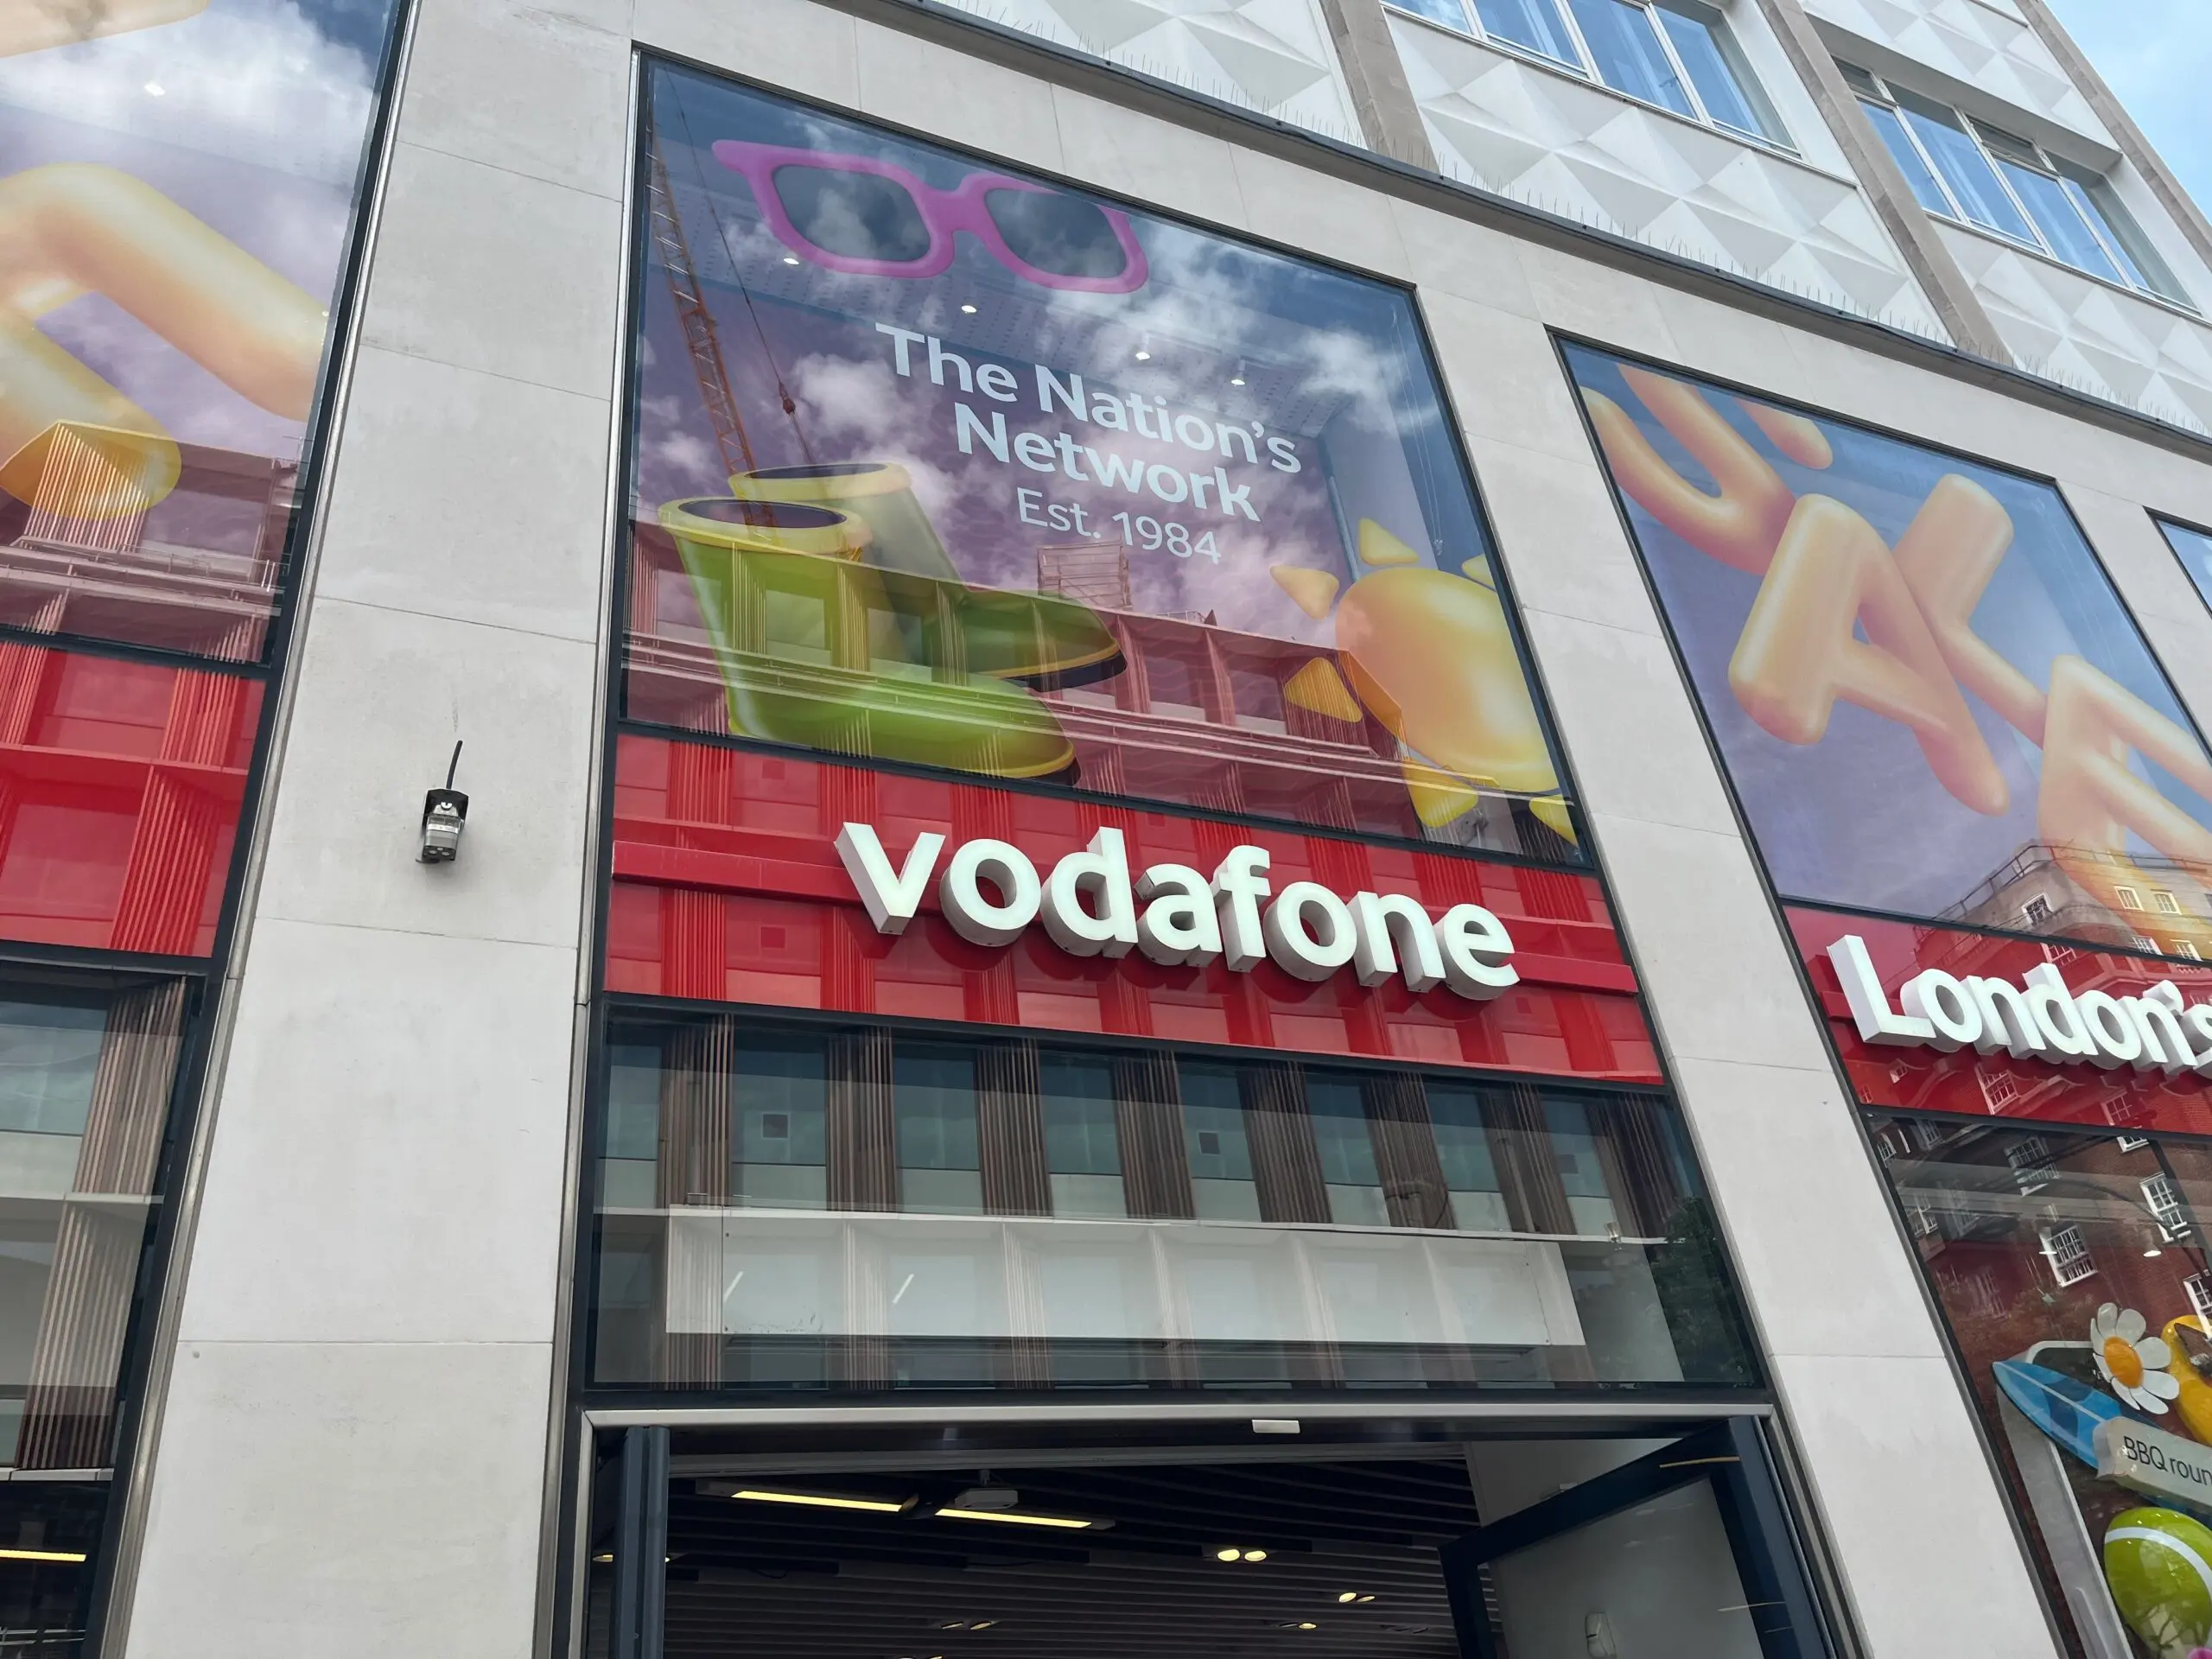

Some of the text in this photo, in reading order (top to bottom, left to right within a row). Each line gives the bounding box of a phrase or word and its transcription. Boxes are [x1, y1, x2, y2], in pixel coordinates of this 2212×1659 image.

[874, 322, 1301, 474] The Nation's
[954, 402, 1262, 522] Network
[1016, 486, 1222, 565] Est. 1984
[834, 821, 1522, 1001] vodafone
[2123, 1435, 2212, 1486] BBQ roun
